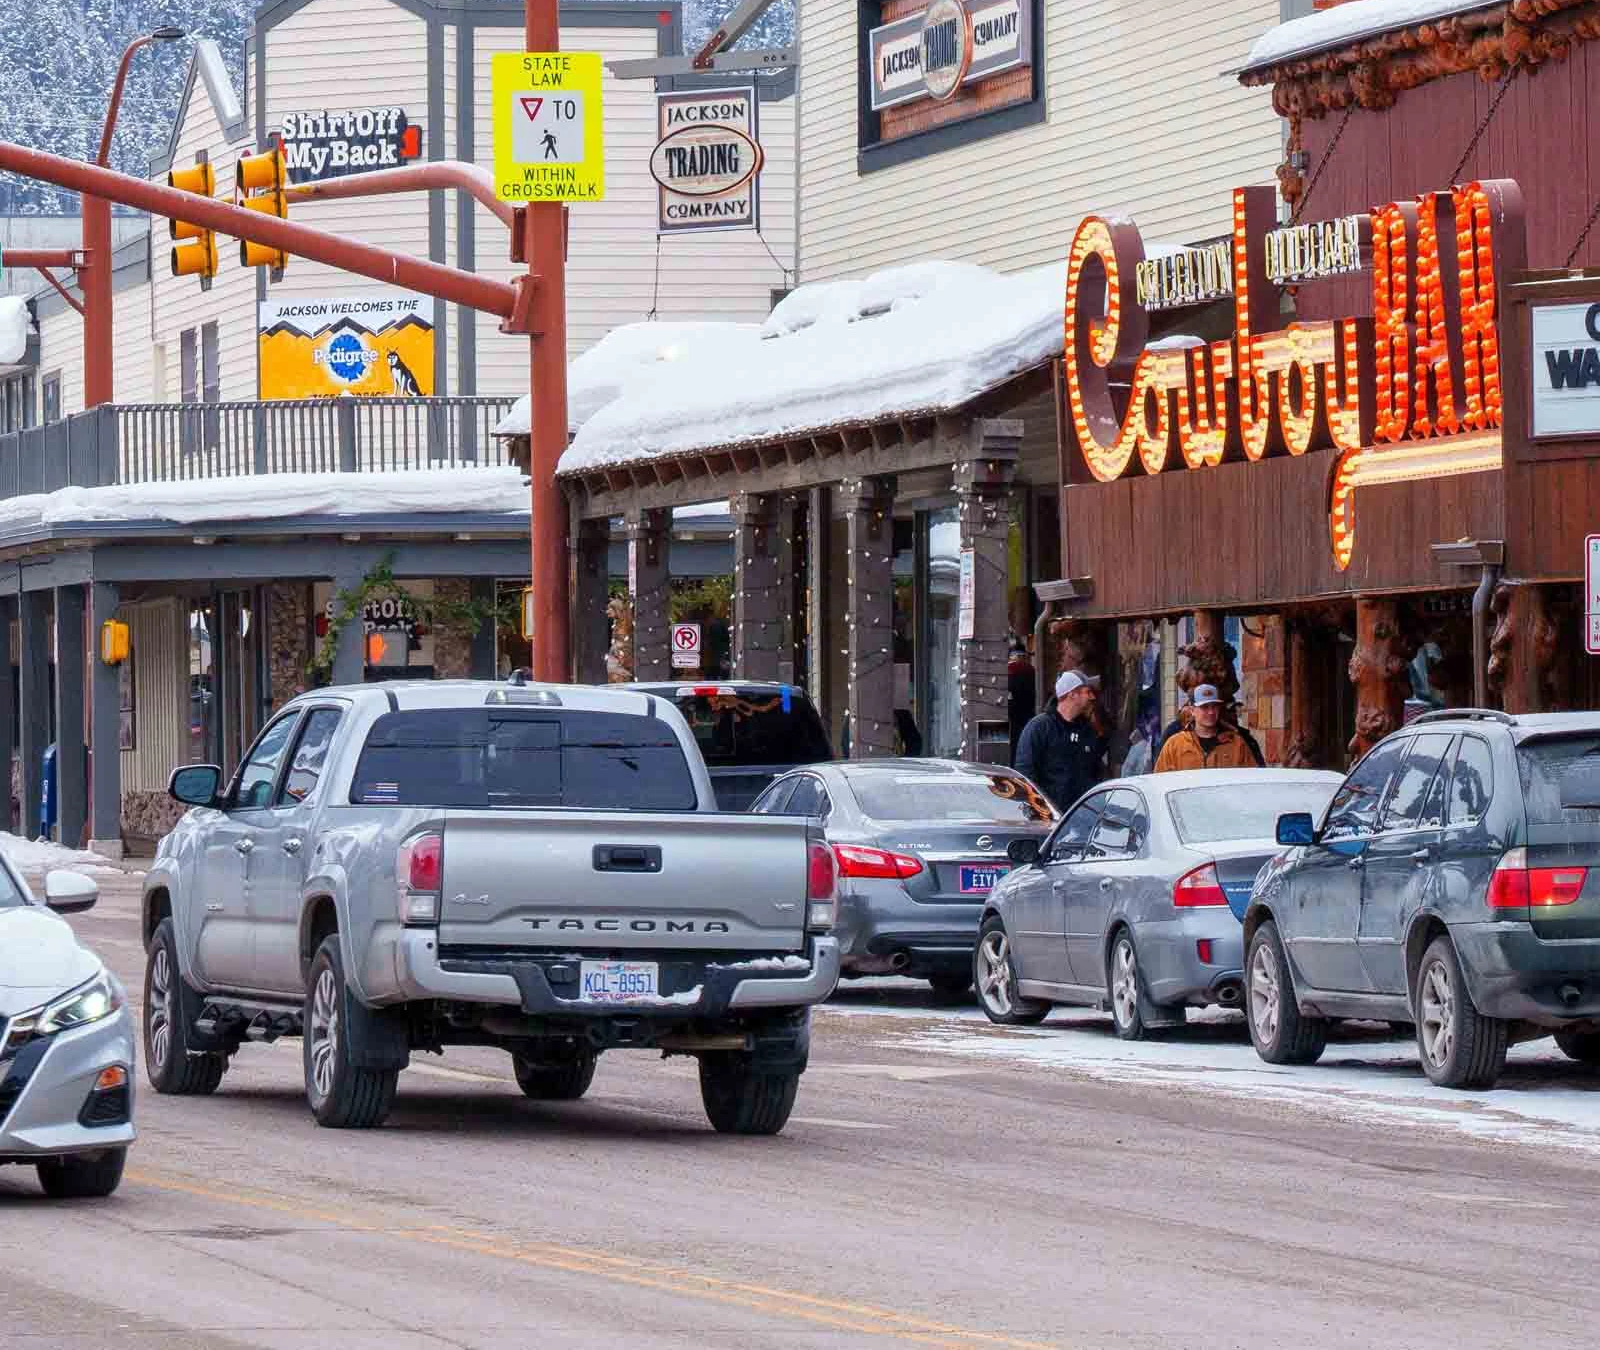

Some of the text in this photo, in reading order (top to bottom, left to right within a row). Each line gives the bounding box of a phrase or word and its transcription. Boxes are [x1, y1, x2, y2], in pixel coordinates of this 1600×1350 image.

[974, 11, 1018, 46] COMPANY
[523, 57, 571, 70] STATE
[531, 73, 562, 86] LAW
[553, 100, 576, 120] TO
[667, 103, 745, 127] JACKSON
[665, 143, 741, 179] TRADING
[524, 168, 576, 181] WITHIN
[502, 183, 597, 197] CROSSWALK
[667, 200, 747, 219] COMPANY
[276, 300, 420, 317] JACKSON WELCOMES THE
[1369, 181, 1505, 444] BAR
[312, 346, 379, 366] Pedigree
[1593, 542, 1599, 551] 3
[521, 917, 730, 934] TACOMA
[584, 972, 656, 993] KCL-8951
